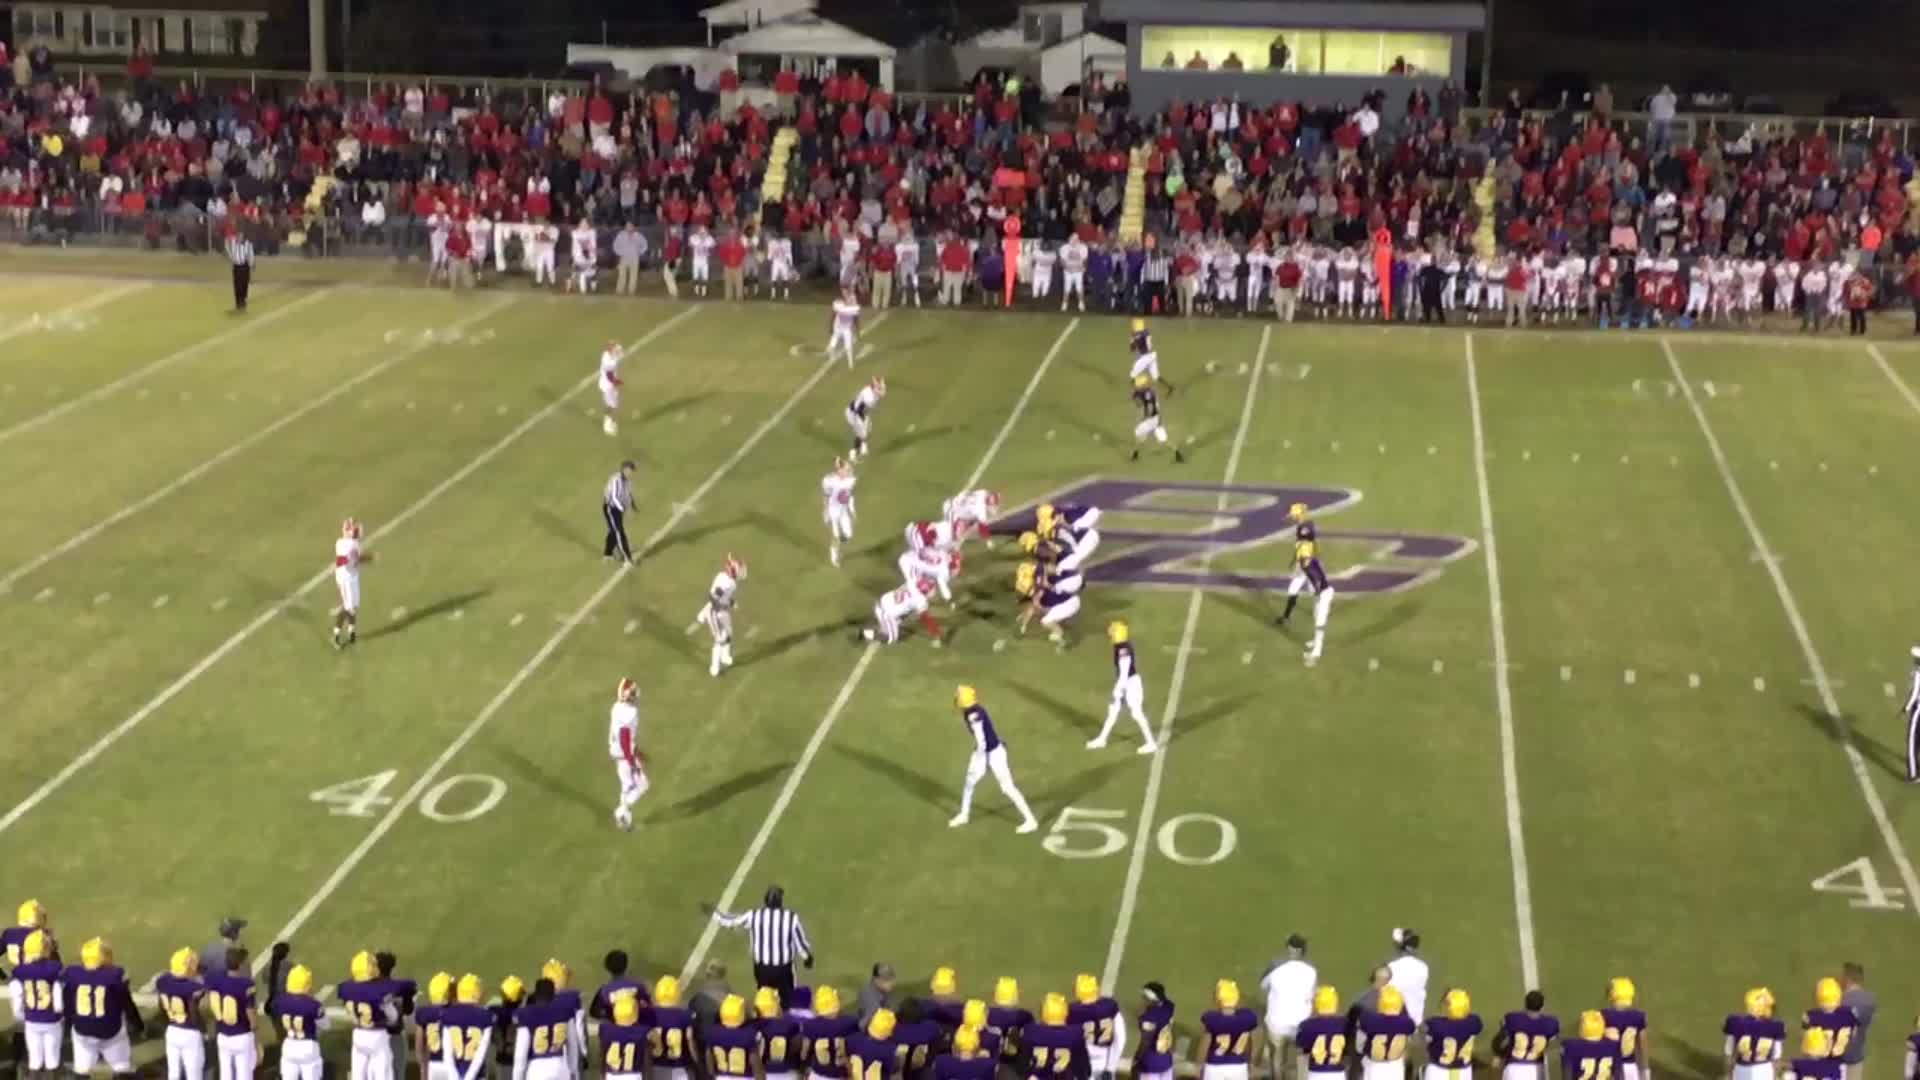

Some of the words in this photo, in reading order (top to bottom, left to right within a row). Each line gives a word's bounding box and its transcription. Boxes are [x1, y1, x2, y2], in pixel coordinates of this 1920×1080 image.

[308, 768, 508, 824] 40
[1041, 805, 1238, 866] 50
[1811, 857, 1905, 910] 4
[605, 1042, 636, 1071] 41
